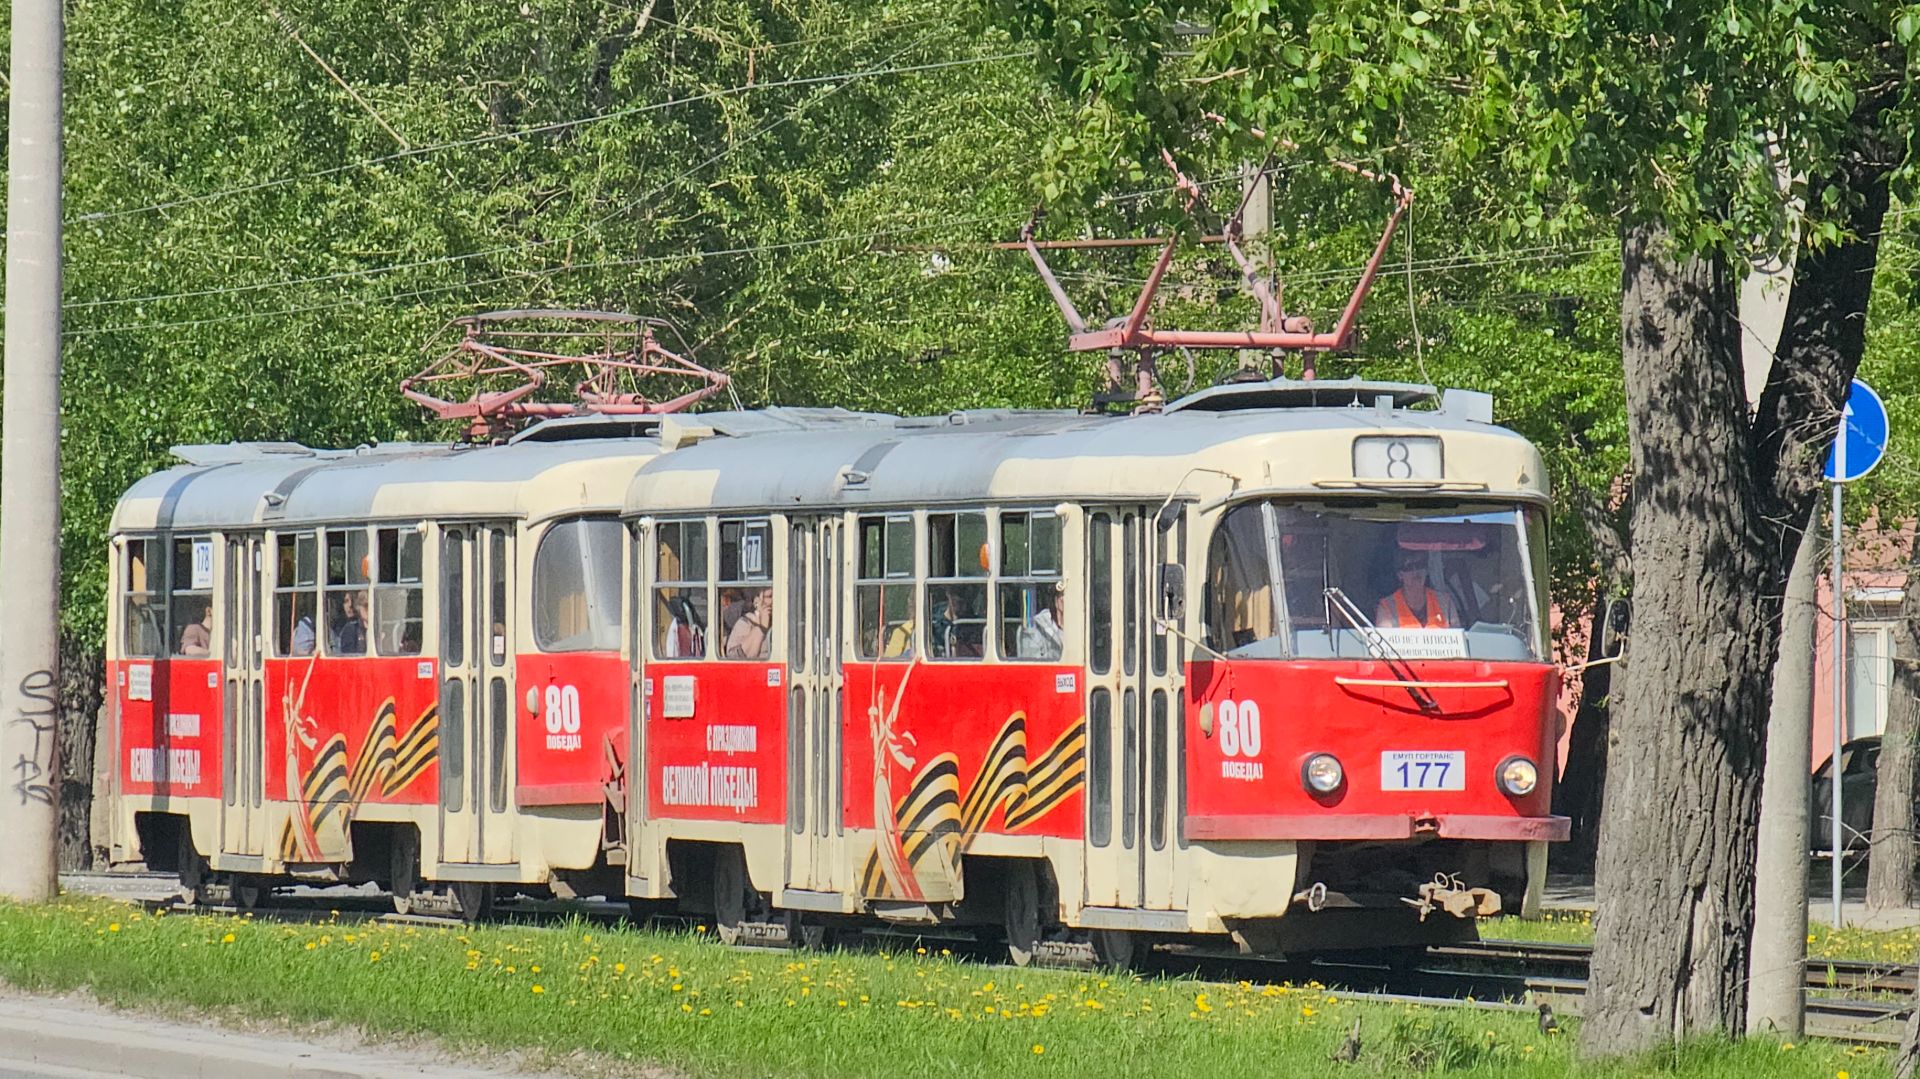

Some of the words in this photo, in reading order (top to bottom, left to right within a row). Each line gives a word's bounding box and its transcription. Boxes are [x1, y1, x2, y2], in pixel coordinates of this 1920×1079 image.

[1387, 441, 1412, 478] 8
[196, 545, 209, 572] 178
[545, 685, 581, 734] 80
[546, 735, 582, 752] ПОБЕДА!
[706, 725, 712, 752] С
[713, 725, 757, 757] ПРАЗДНИКОМ
[1219, 699, 1262, 757] 80
[663, 761, 709, 806] ВЕЛИКОЙ
[710, 766, 758, 814] ПОБЕДЫ!
[1222, 761, 1264, 782] ПОБЕДА!
[1397, 762, 1451, 788] 177
